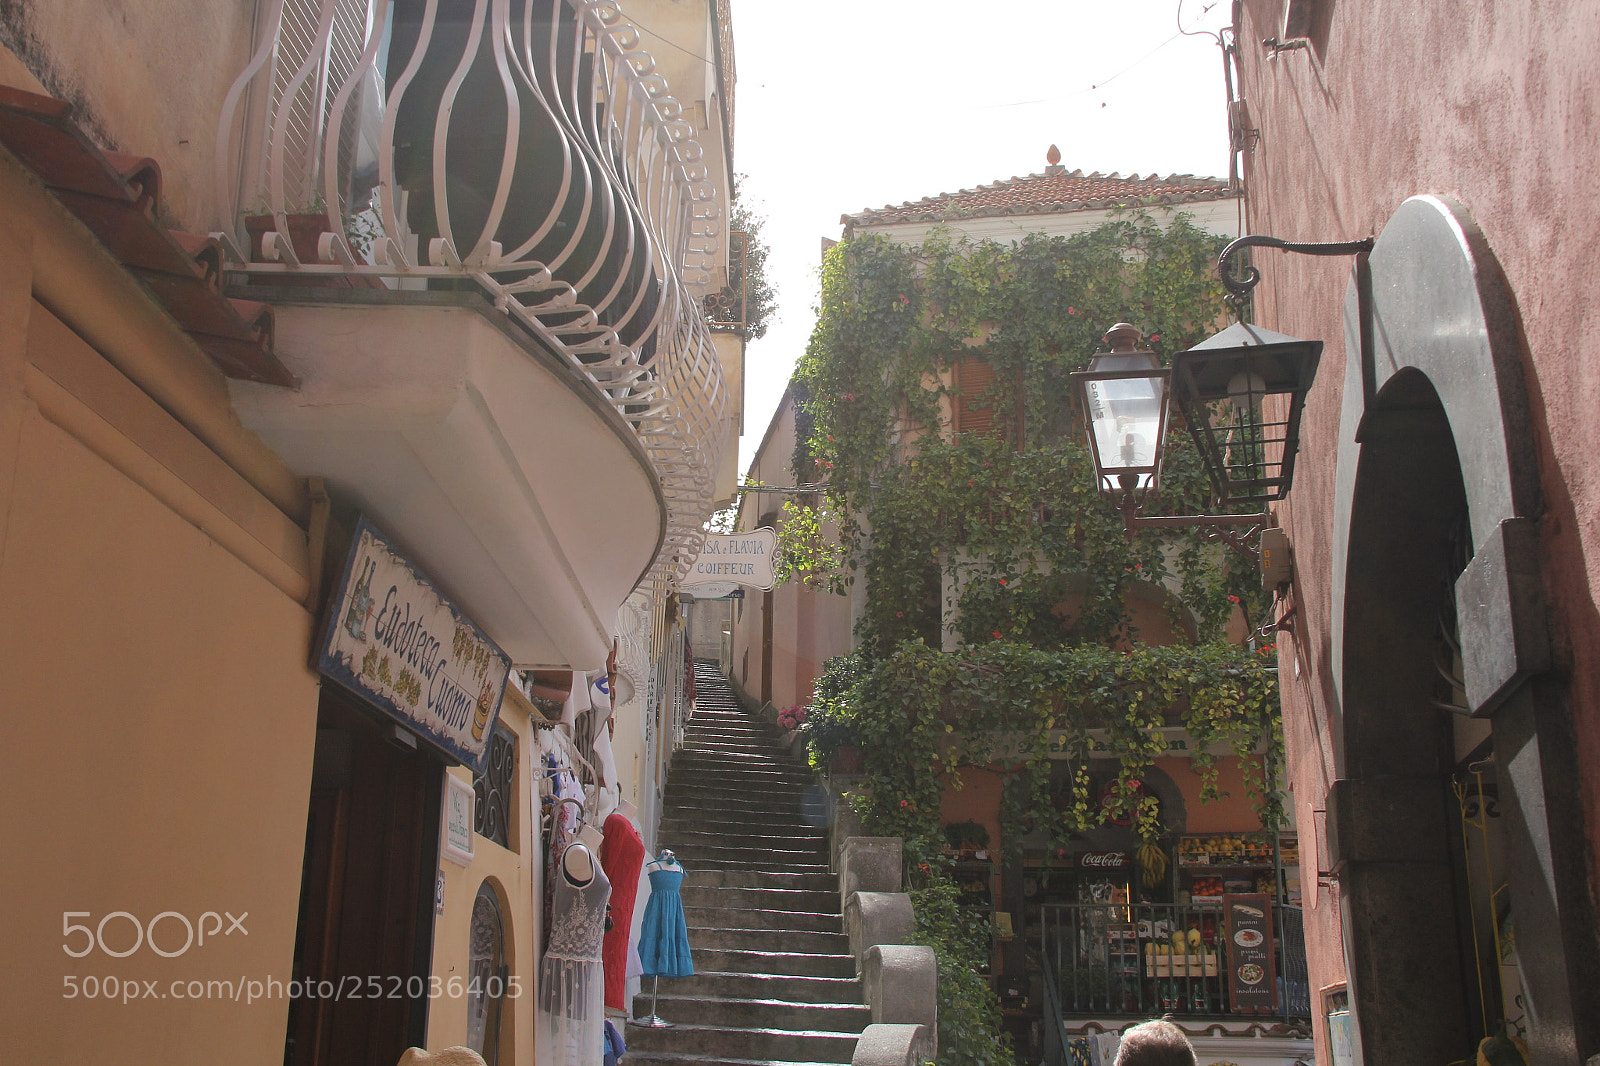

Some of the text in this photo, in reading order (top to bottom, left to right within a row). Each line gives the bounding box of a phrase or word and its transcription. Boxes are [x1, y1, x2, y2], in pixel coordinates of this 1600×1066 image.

[729, 540, 765, 555] FLAVIA
[697, 562, 755, 575] COIFFEUR
[427, 658, 472, 732] Cuomo
[1081, 852, 1126, 867] Coca-Cola
